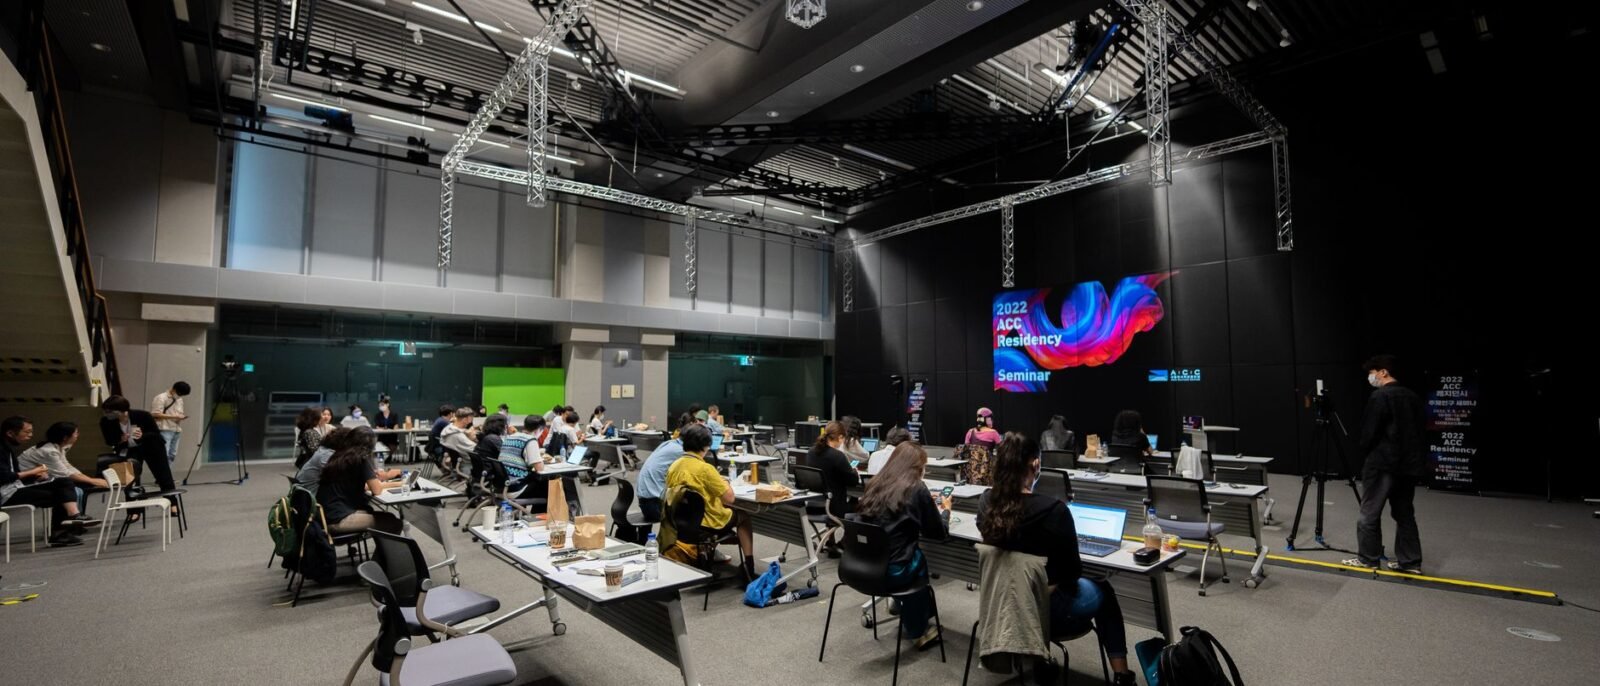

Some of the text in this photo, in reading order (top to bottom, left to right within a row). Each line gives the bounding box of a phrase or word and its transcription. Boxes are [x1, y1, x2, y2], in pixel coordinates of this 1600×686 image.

[997, 301, 1027, 316] 2022
[997, 317, 1021, 331] ACC
[997, 334, 1063, 347] Residency
[998, 369, 1051, 381] Seminar
[1441, 432, 1464, 440] 2022
[1430, 445, 1477, 455] Residency
[1437, 455, 1469, 463] Seminar
